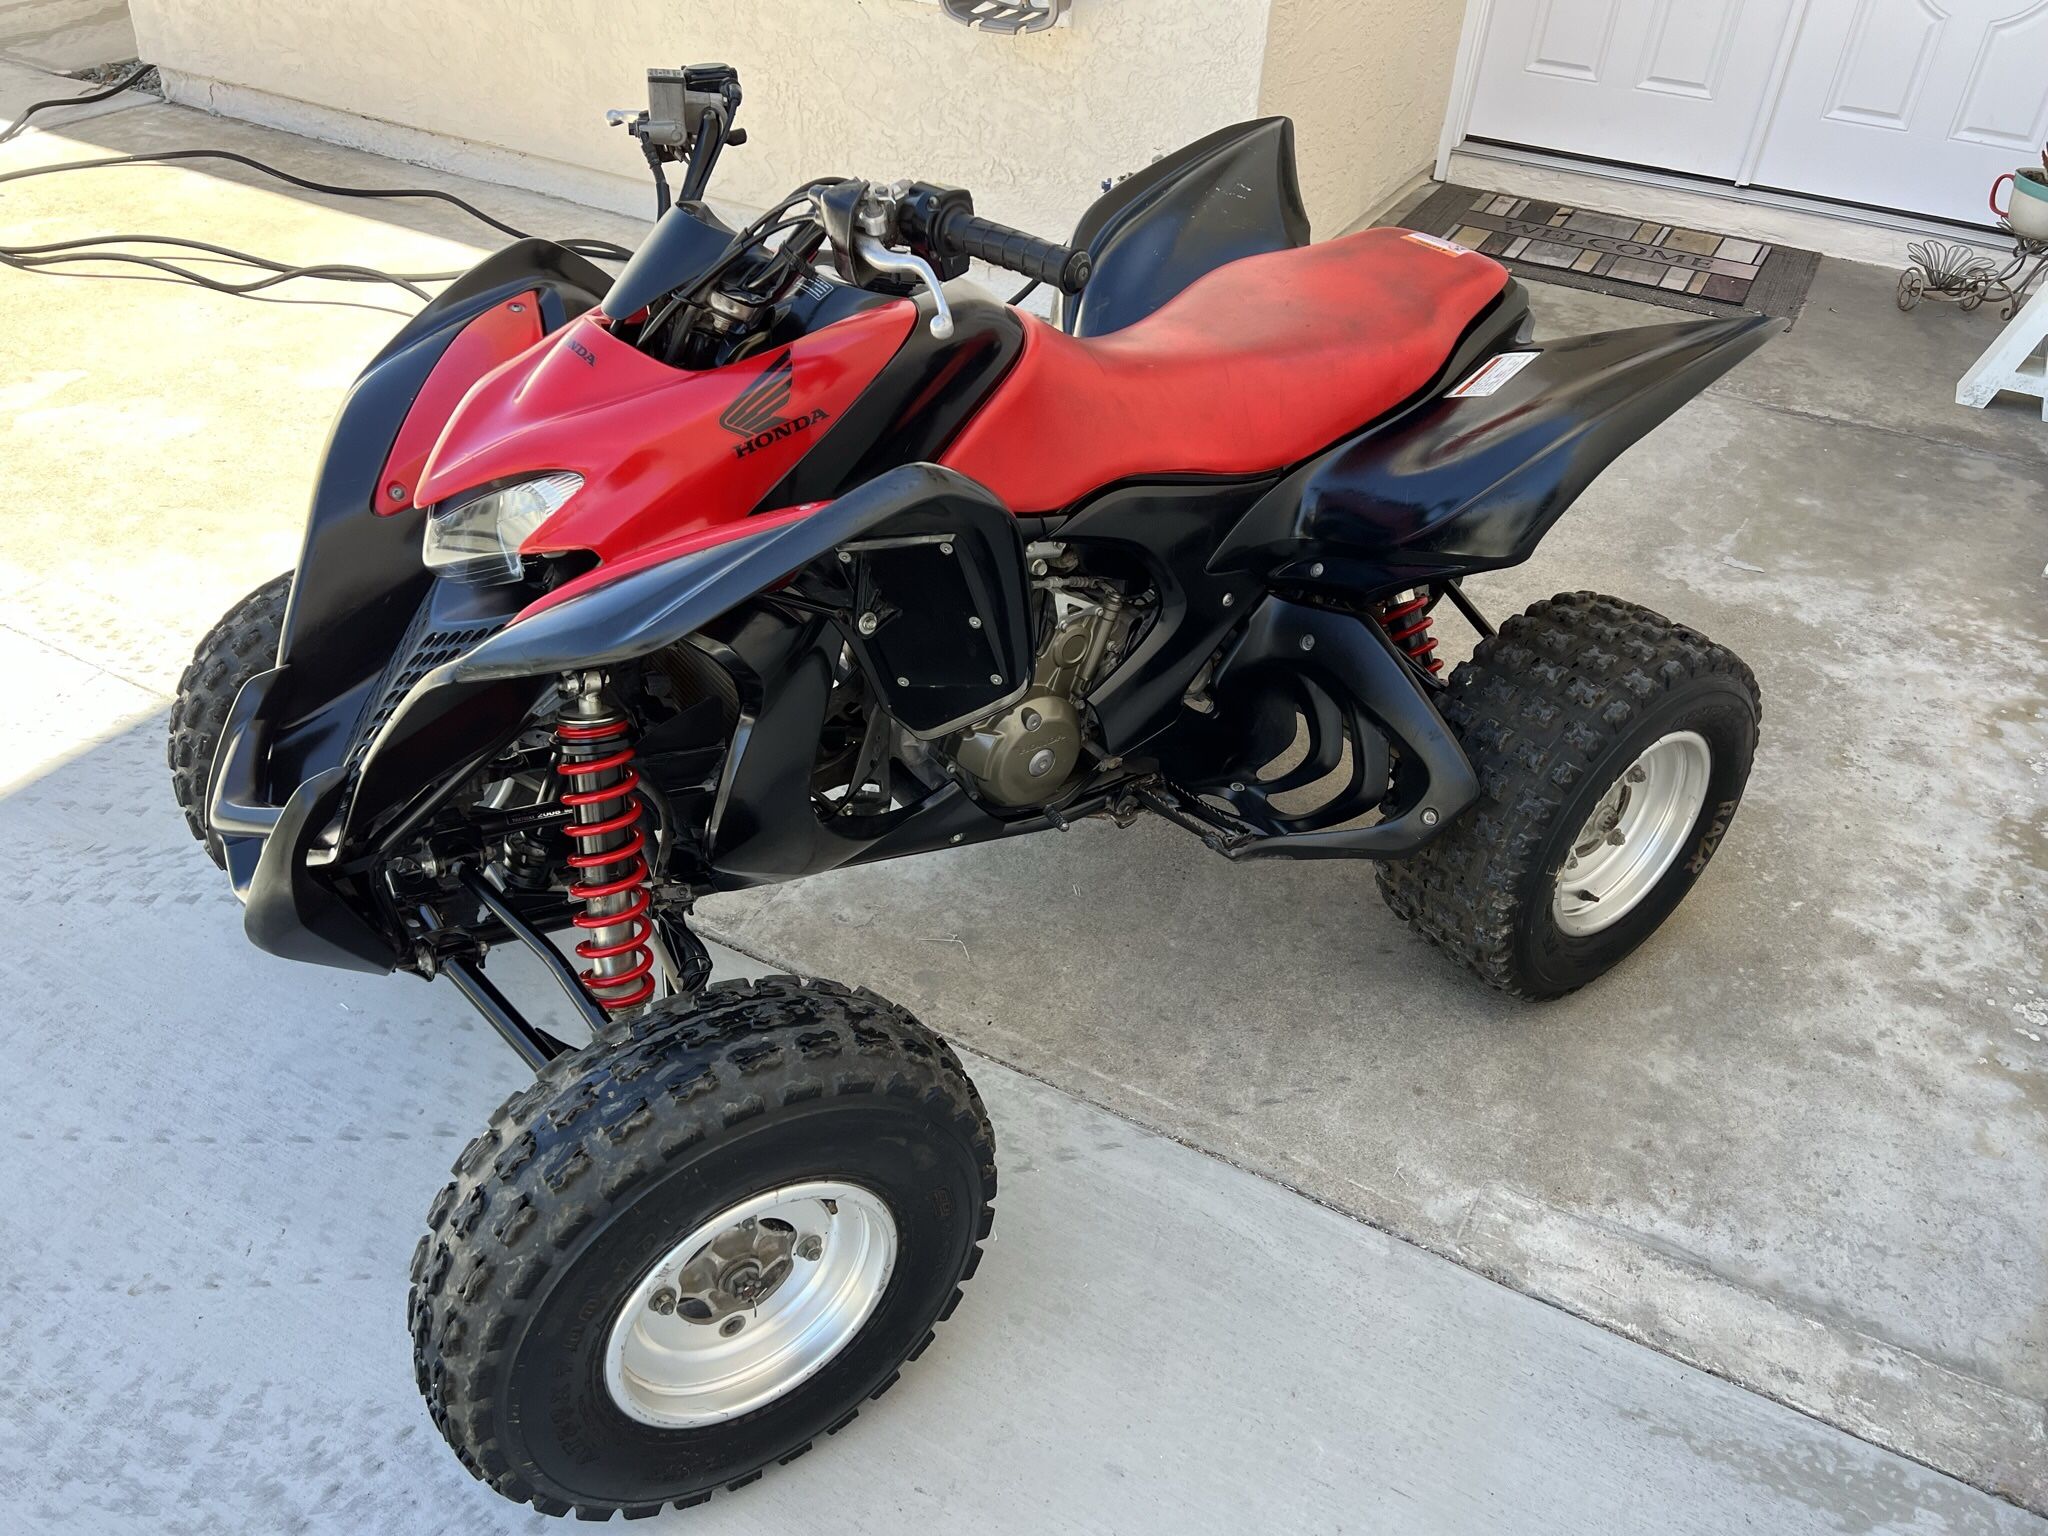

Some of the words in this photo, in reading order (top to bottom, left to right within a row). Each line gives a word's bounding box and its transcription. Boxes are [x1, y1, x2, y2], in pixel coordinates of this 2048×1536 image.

[1504, 221, 1715, 269] WELCOME
[734, 408, 830, 458] HONDA
[1684, 800, 1736, 874] RAZR
